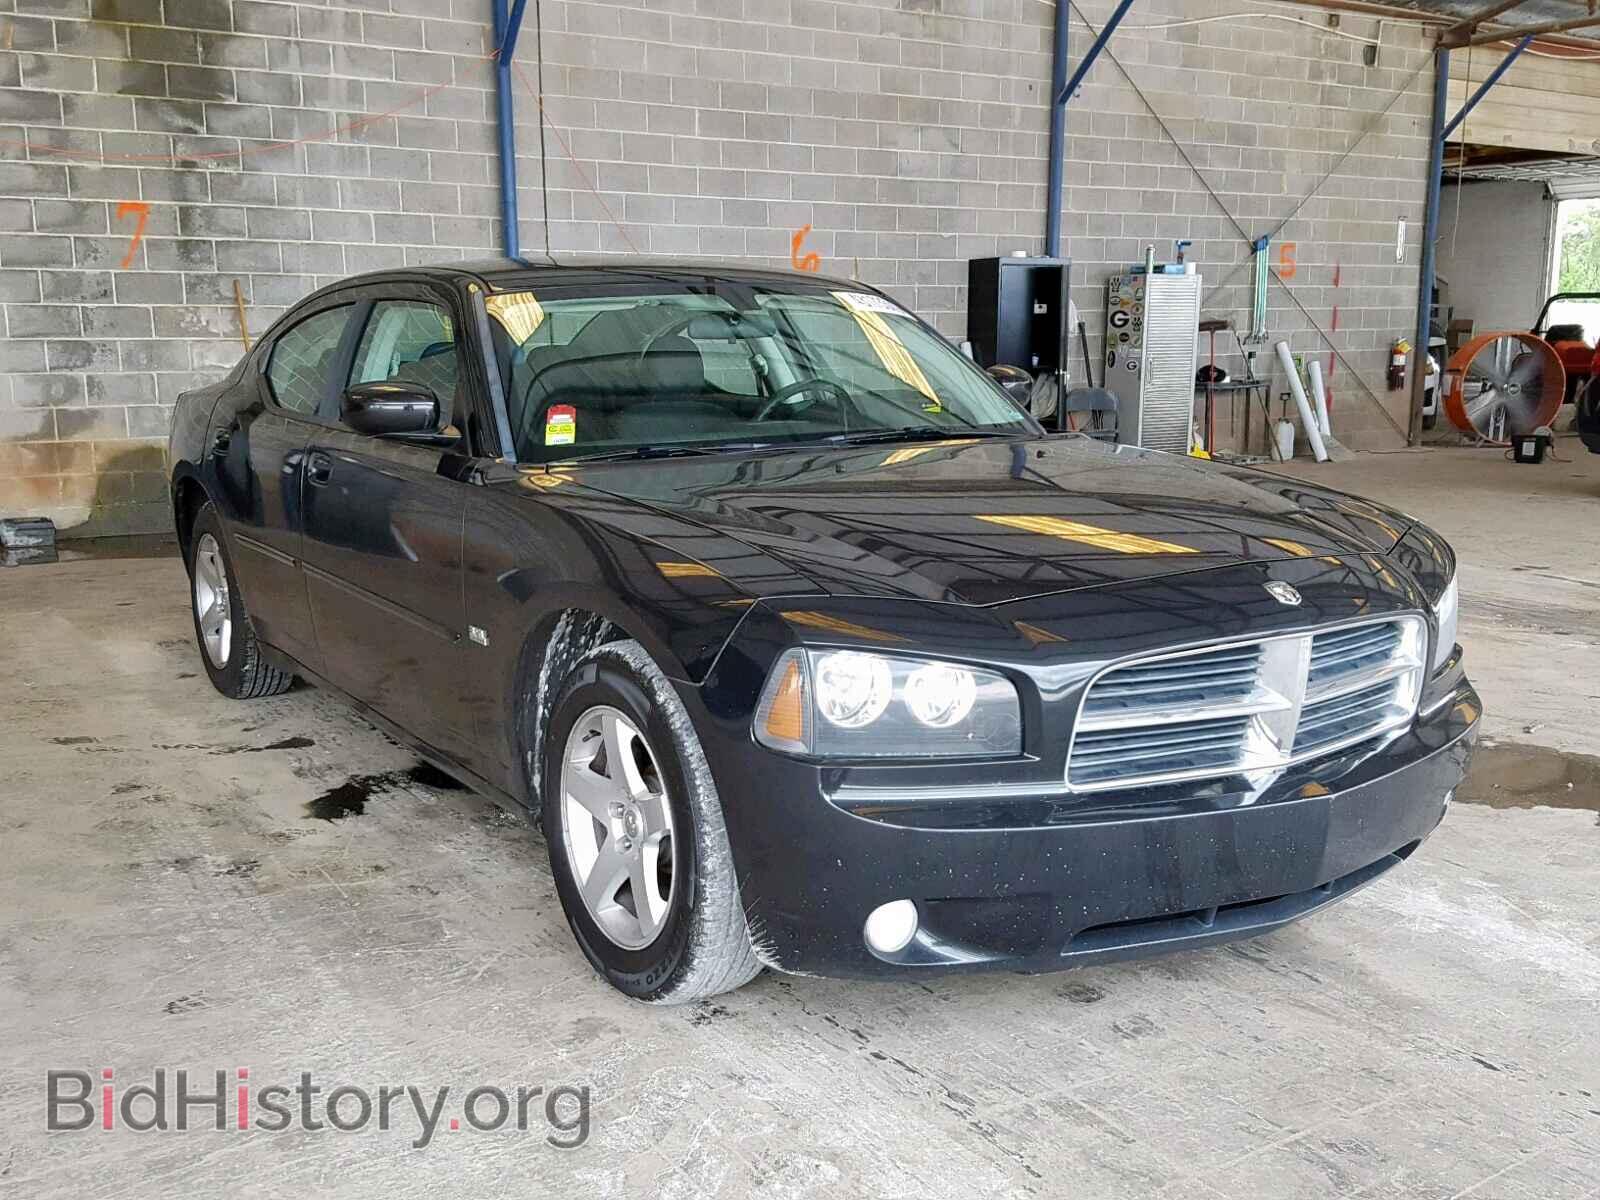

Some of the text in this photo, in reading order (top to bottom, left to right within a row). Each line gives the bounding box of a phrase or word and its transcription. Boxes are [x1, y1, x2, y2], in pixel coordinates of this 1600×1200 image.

[116, 200, 151, 271] 7
[791, 223, 823, 273] 6
[1279, 241, 1297, 280] 5
[1110, 310, 1129, 328] G
[1127, 360, 1137, 370] G
